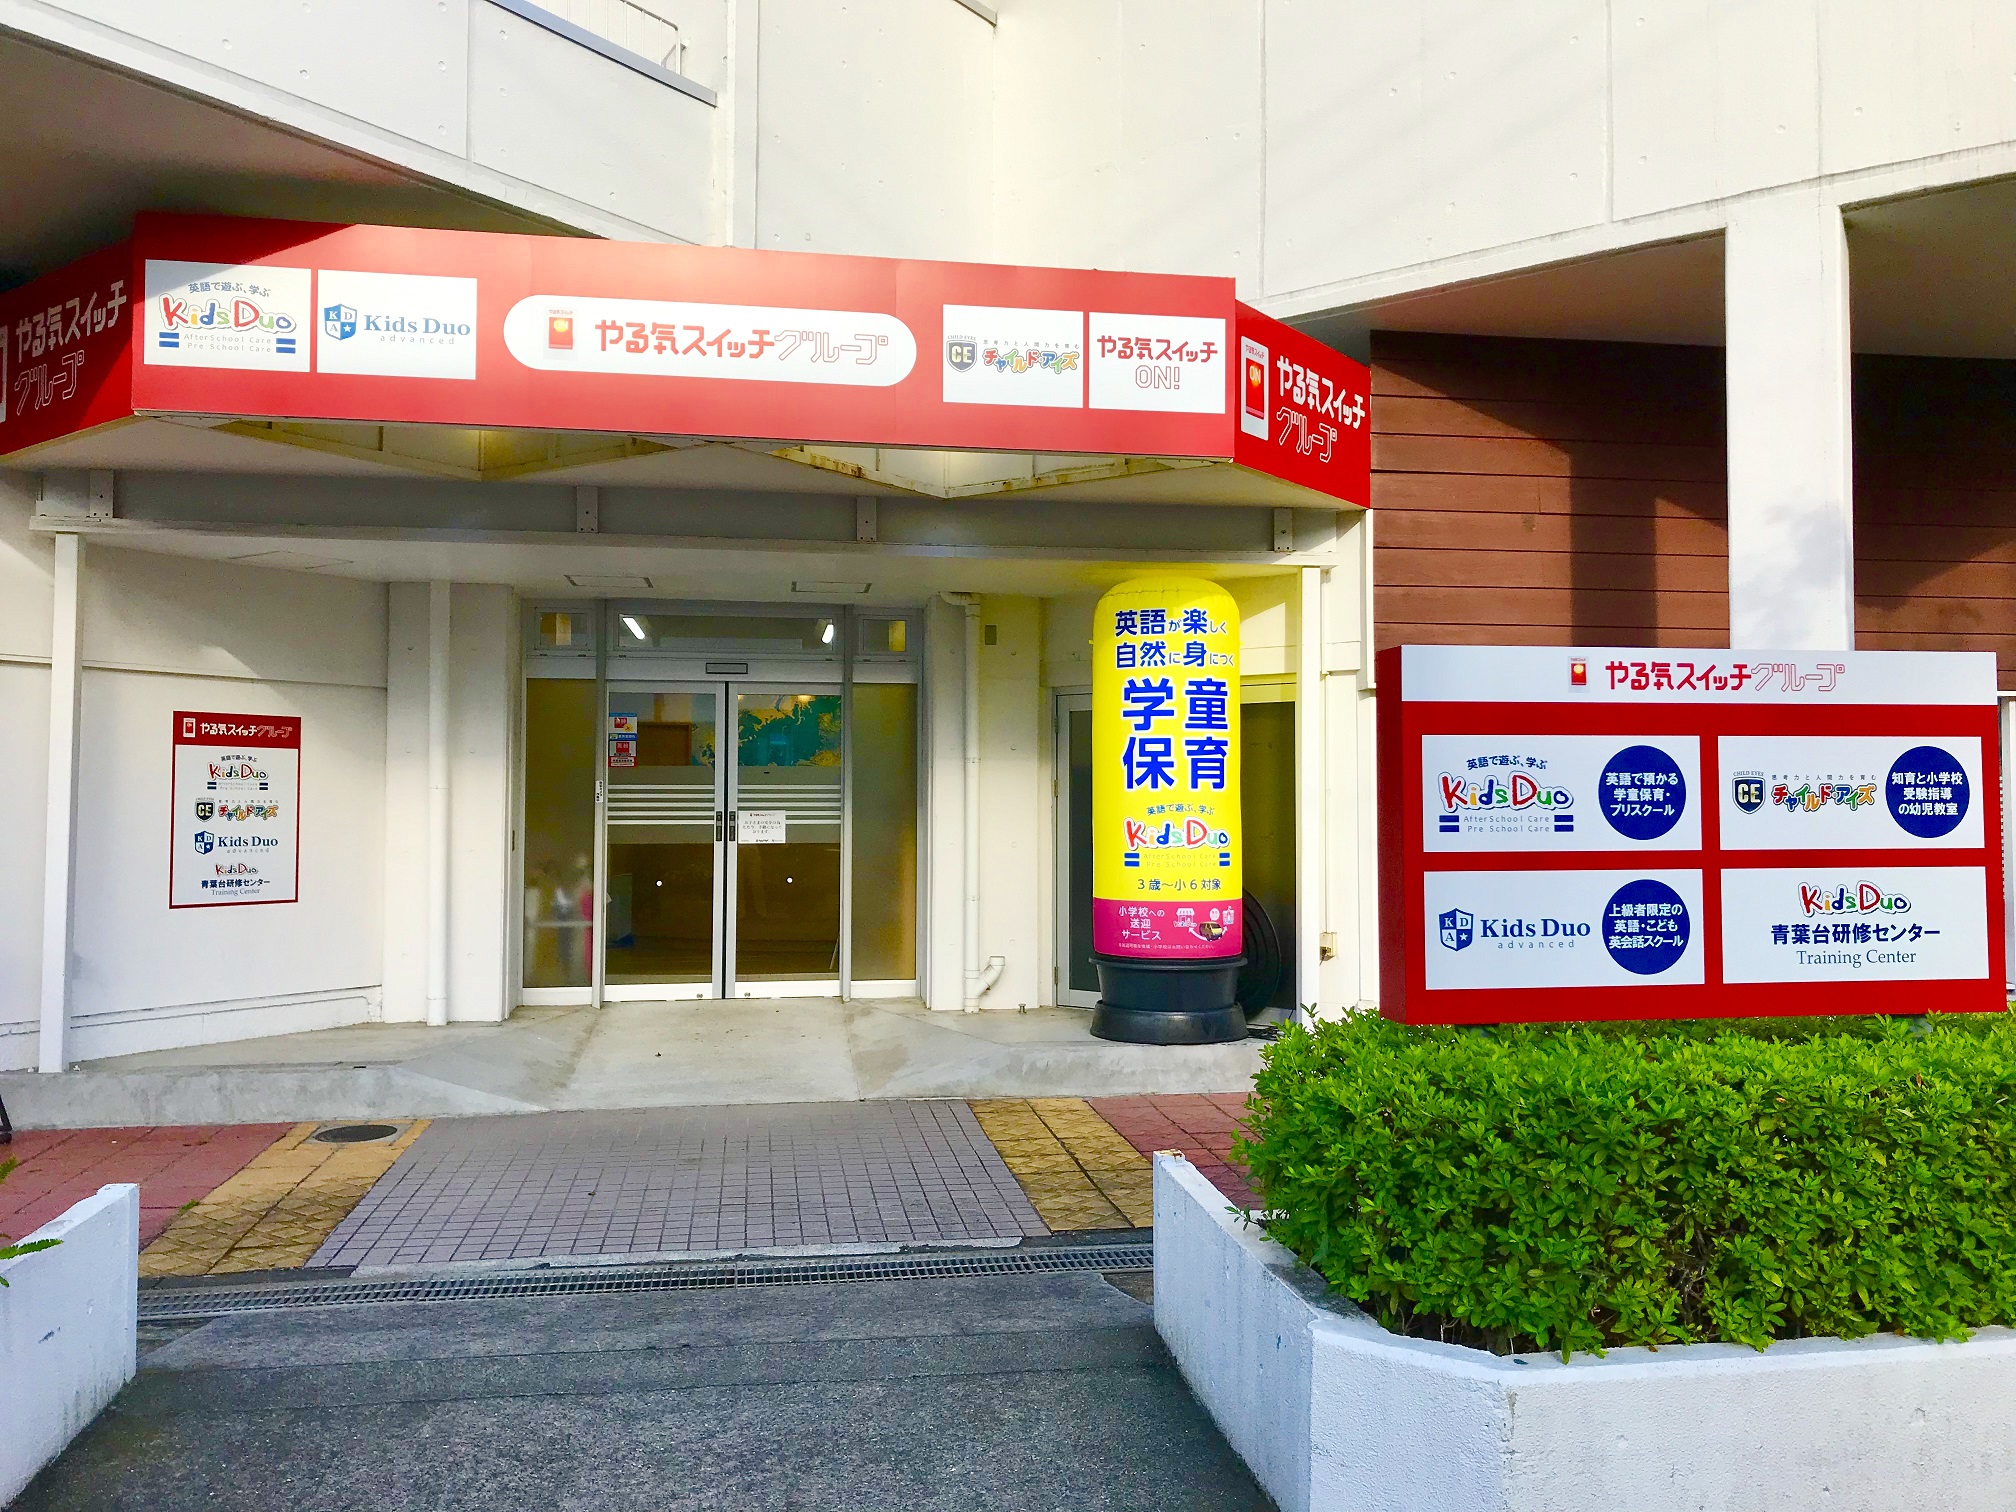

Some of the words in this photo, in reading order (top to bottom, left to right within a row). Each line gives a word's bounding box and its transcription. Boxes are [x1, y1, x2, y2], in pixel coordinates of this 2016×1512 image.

[16, 280, 126, 363] やる気スイッチ
[364, 314, 417, 333] Kids
[422, 317, 471, 336] Duo
[249, 336, 271, 344] Care
[380, 335, 454, 345] advanced
[595, 319, 889, 366] やる気スイッチグループ
[249, 345, 271, 353] Care
[951, 345, 973, 363] CE
[1097, 335, 1218, 364] やる気スイッチ
[14, 349, 84, 416] グループ
[1135, 365, 1180, 390] ON!
[1277, 355, 1365, 429] やる気スイッチ
[1276, 406, 1337, 463] グループ
[1115, 608, 1227, 637] 英語が楽しく
[1116, 640, 1234, 669] 自然に身につく
[1605, 660, 1846, 692] やる気スイッチグループ
[200, 722, 293, 739] やる気スイッチグループ
[1466, 755, 1548, 771] 英語で遊ぶ、学ぶ
[1605, 772, 1679, 786] 英語で預かる
[1891, 771, 1963, 785] 知育と小学校
[1737, 783, 1761, 804] CE
[1903, 787, 1953, 801] 受験指導
[197, 804, 212, 817] CE
[1146, 803, 1216, 816] 英語で遊ぶ、学ぶ
[1898, 802, 1959, 816] の幼児教室
[1527, 815, 1550, 823] Care
[217, 836, 249, 848] Kids
[251, 835, 279, 847] Duo
[1118, 906, 1165, 918] 小学校への
[1608, 903, 1683, 917] 上級者限定の
[1130, 918, 1151, 929] 送迎
[1480, 918, 1536, 938] Kids
[1541, 918, 1591, 937] Duo
[1614, 919, 1678, 933] 英語・こども
[1121, 930, 1162, 941] サービス
[1770, 923, 1941, 945] 青葉台研修センター
[1497, 939, 1575, 949] advanced
[1609, 935, 1684, 949] 英会話スクール
[1796, 950, 1862, 968] Training
[1866, 948, 1917, 964] Center
